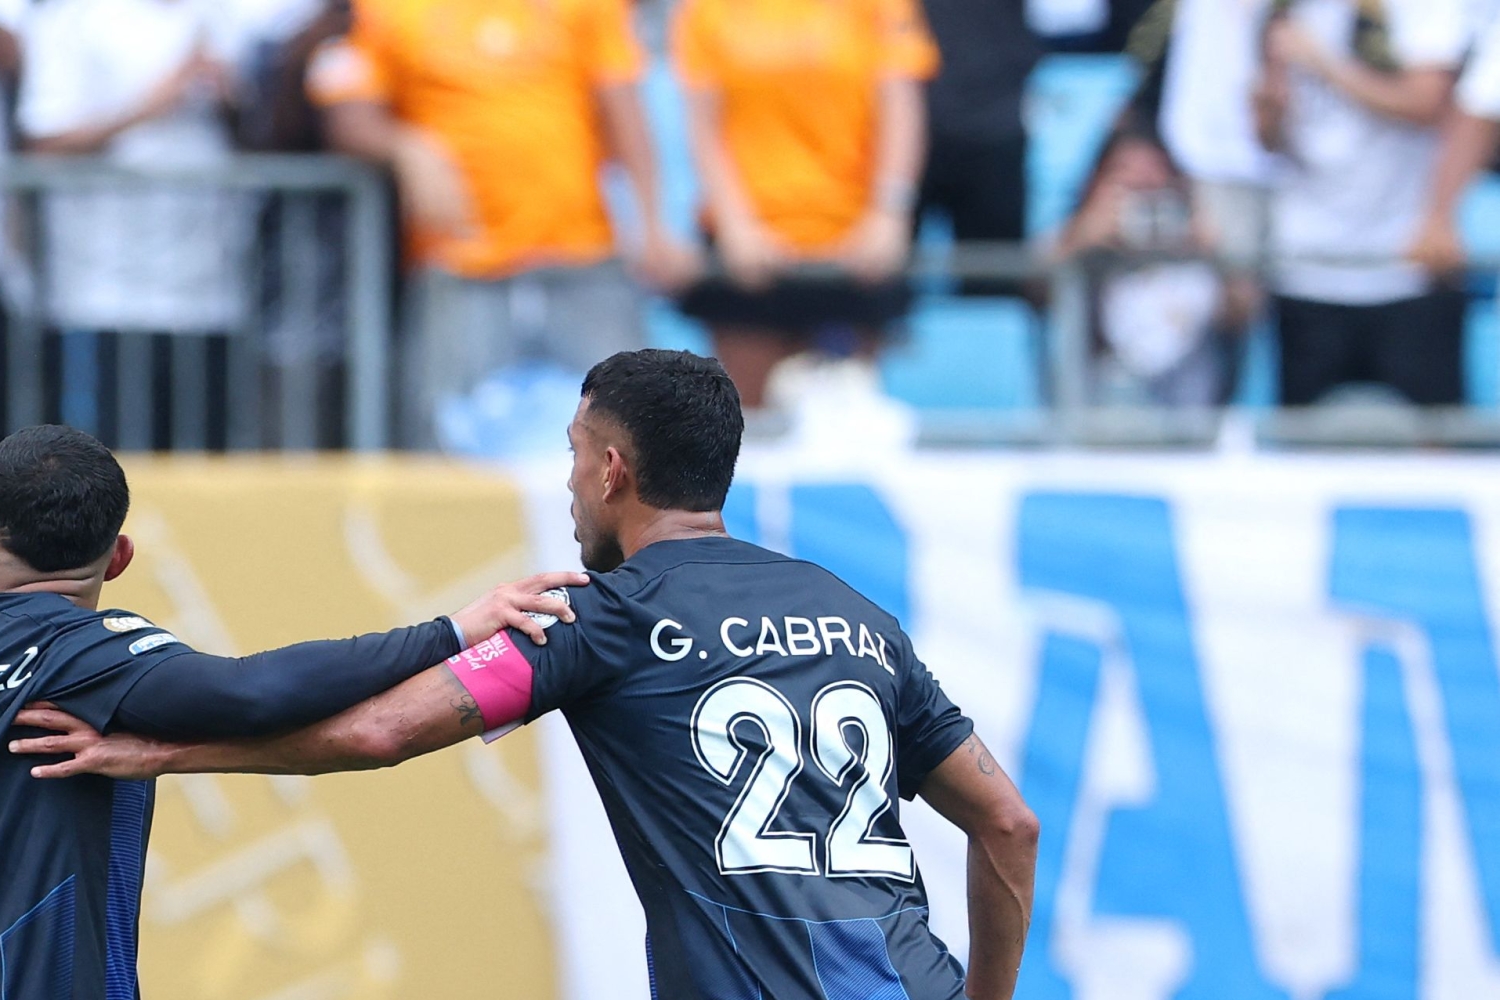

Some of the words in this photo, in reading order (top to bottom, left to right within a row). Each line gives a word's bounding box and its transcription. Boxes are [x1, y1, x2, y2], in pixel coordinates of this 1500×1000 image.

[650, 618, 707, 662] G.
[720, 616, 895, 676] CABRAL
[690, 675, 917, 884] 22
